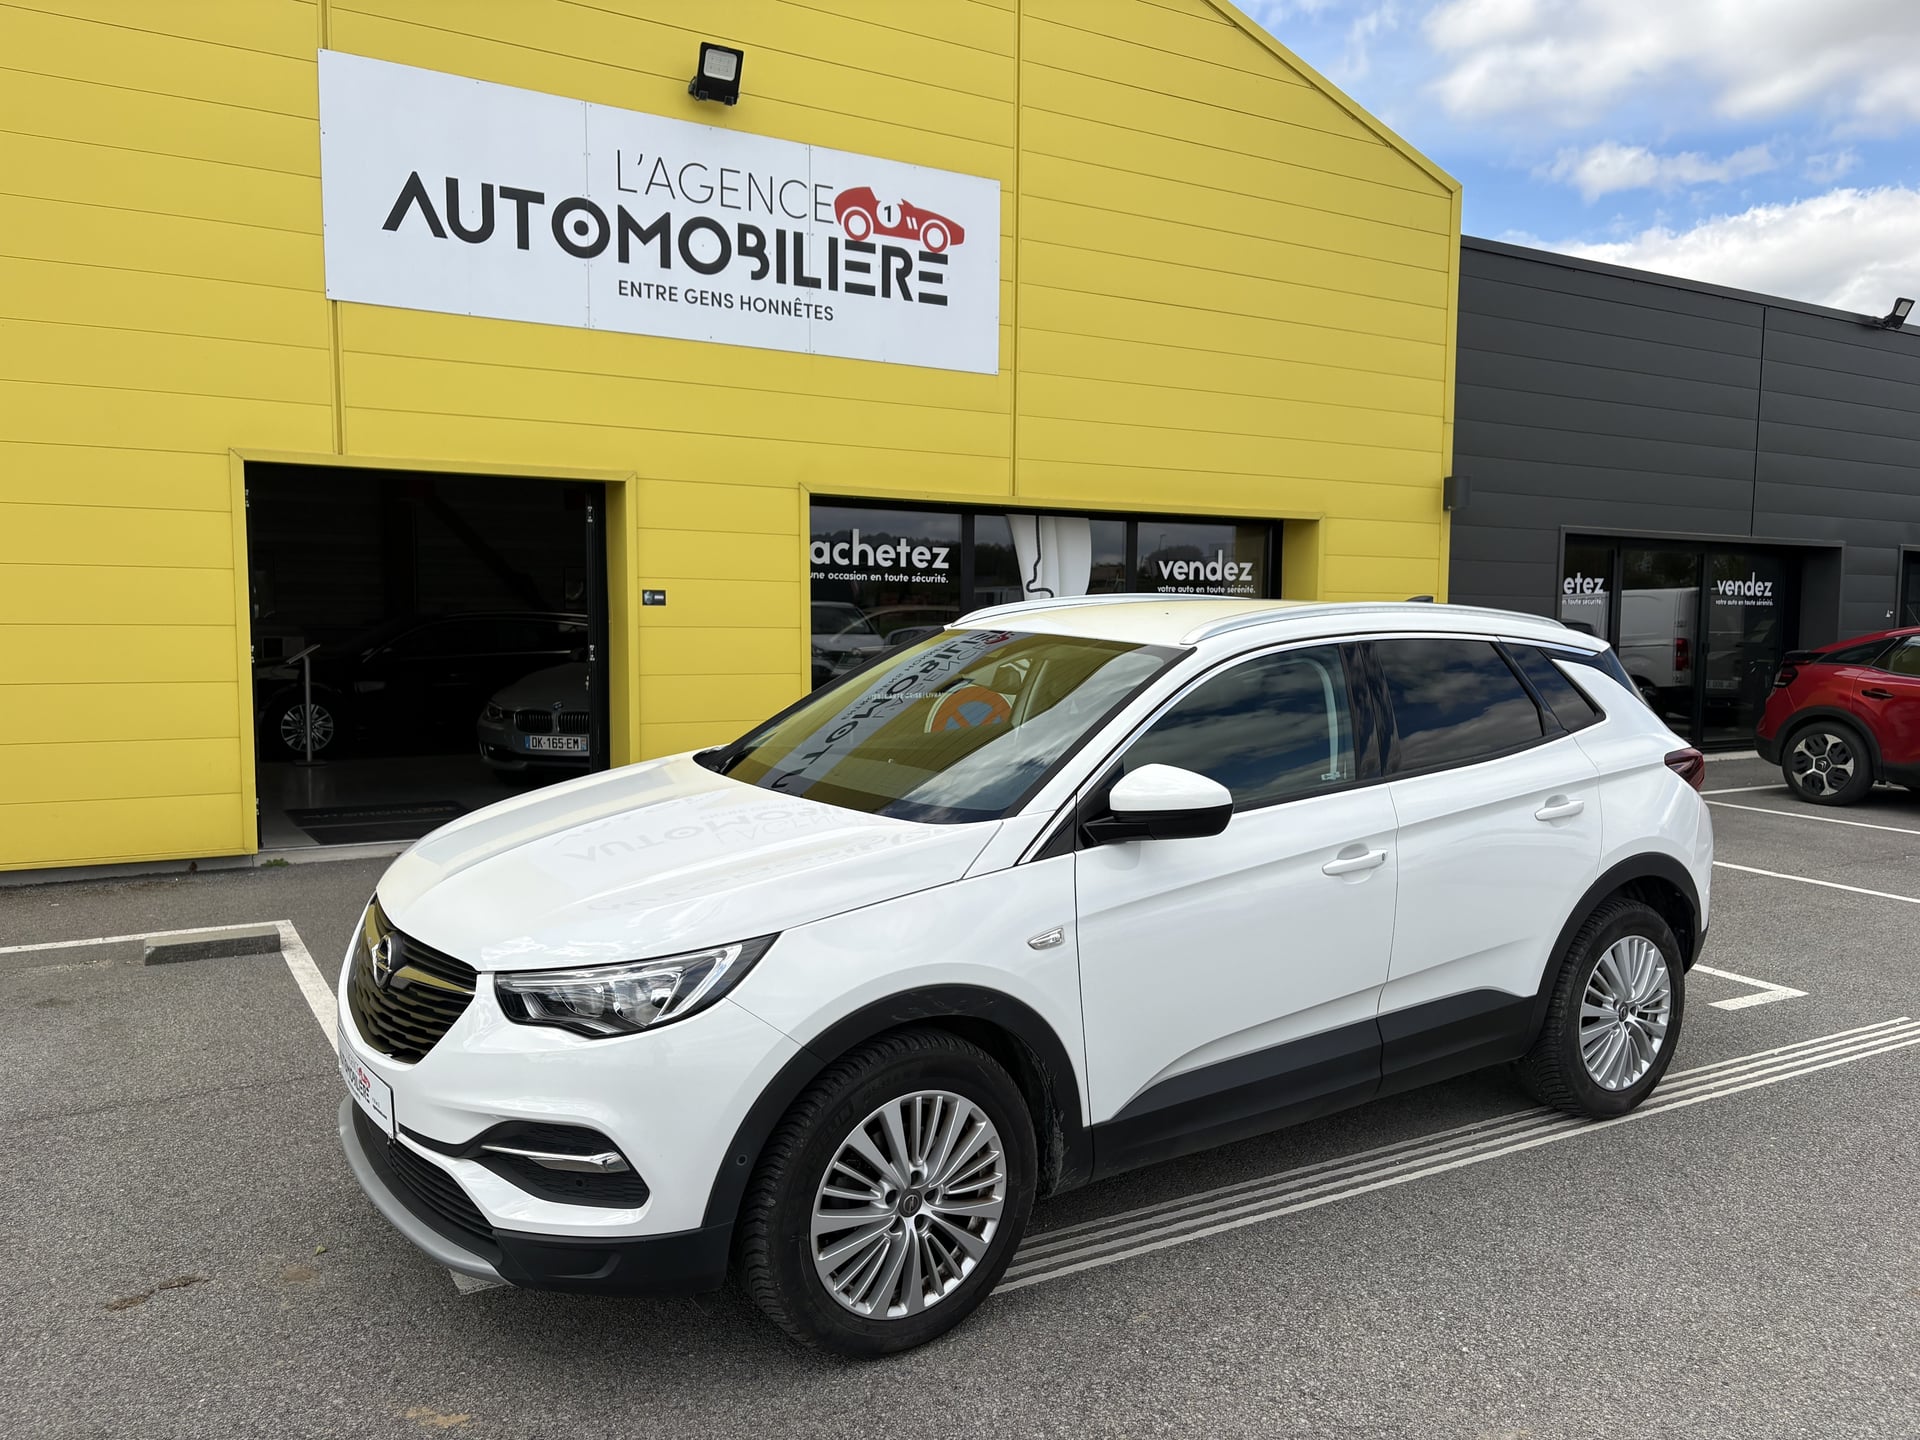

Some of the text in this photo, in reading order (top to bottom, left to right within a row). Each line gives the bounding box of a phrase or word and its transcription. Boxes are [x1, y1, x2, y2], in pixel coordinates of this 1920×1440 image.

[616, 149, 834, 224] L'AGENCE
[382, 170, 949, 307] AUTOMOBILIERE
[618, 279, 834, 321] ENTRE GENS HONNÊTES
[810, 528, 950, 569] achetez
[828, 570, 867, 581] occasion
[870, 573, 882, 581] en
[884, 573, 909, 582] toute
[911, 572, 949, 583] sécurité.
[1158, 549, 1254, 582] vendez
[1157, 585, 1176, 593] votre
[1177, 585, 1194, 593] auto
[1206, 585, 1225, 594] toute
[1563, 572, 1604, 594] etez
[1717, 571, 1773, 597] vendez
